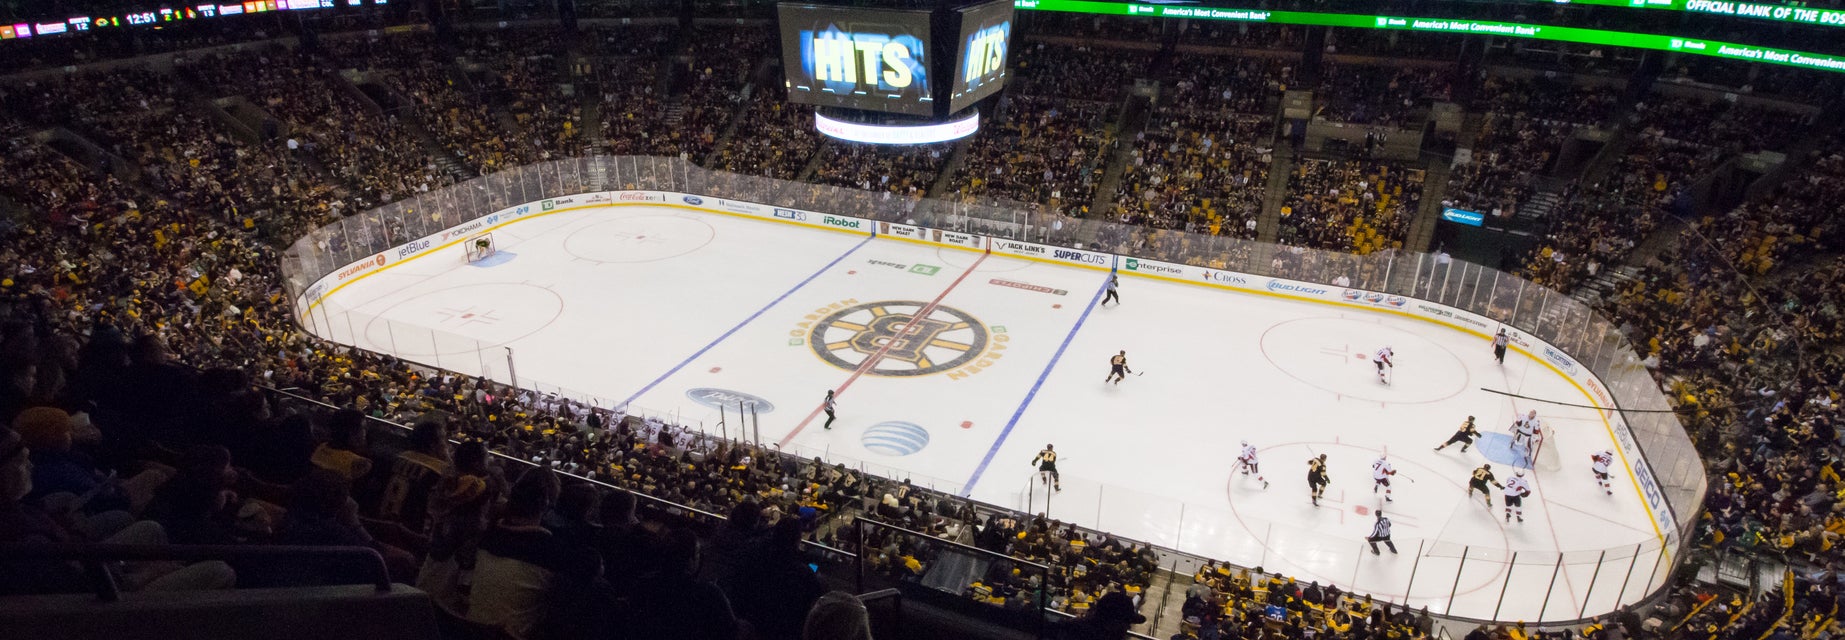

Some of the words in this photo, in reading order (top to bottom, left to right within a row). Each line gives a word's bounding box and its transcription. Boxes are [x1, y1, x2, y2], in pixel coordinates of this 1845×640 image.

[1163, 8, 1192, 16] America's
[1194, 9, 1210, 17] Most
[1211, 10, 1248, 19] Convenient
[1686, 0, 1735, 14] OFFICIAL
[1737, 4, 1771, 17] BANK
[1773, 7, 1791, 19] OF
[1794, 9, 1819, 21] THE
[1413, 20, 1448, 30] America's
[1450, 22, 1469, 31] Most
[1470, 23, 1514, 33] Convenient
[814, 38, 912, 87] HITS
[965, 30, 1005, 83] HITS
[1718, 45, 1764, 59] America's
[1764, 51, 1789, 62] Most
[555, 198, 574, 206] Bank
[452, 222, 482, 237] YOKOHAMA
[823, 215, 860, 229] iRobot
[398, 240, 430, 260] jetBlue
[1008, 242, 1023, 250] JACK
[1024, 245, 1045, 254] LINK'S
[1053, 249, 1107, 265] SUPERCUTS
[338, 260, 375, 281] SYLVANIA
[790, 298, 859, 338] GARDEN
[946, 333, 1010, 381] GARDEN
[1634, 458, 1660, 510] GEICO
